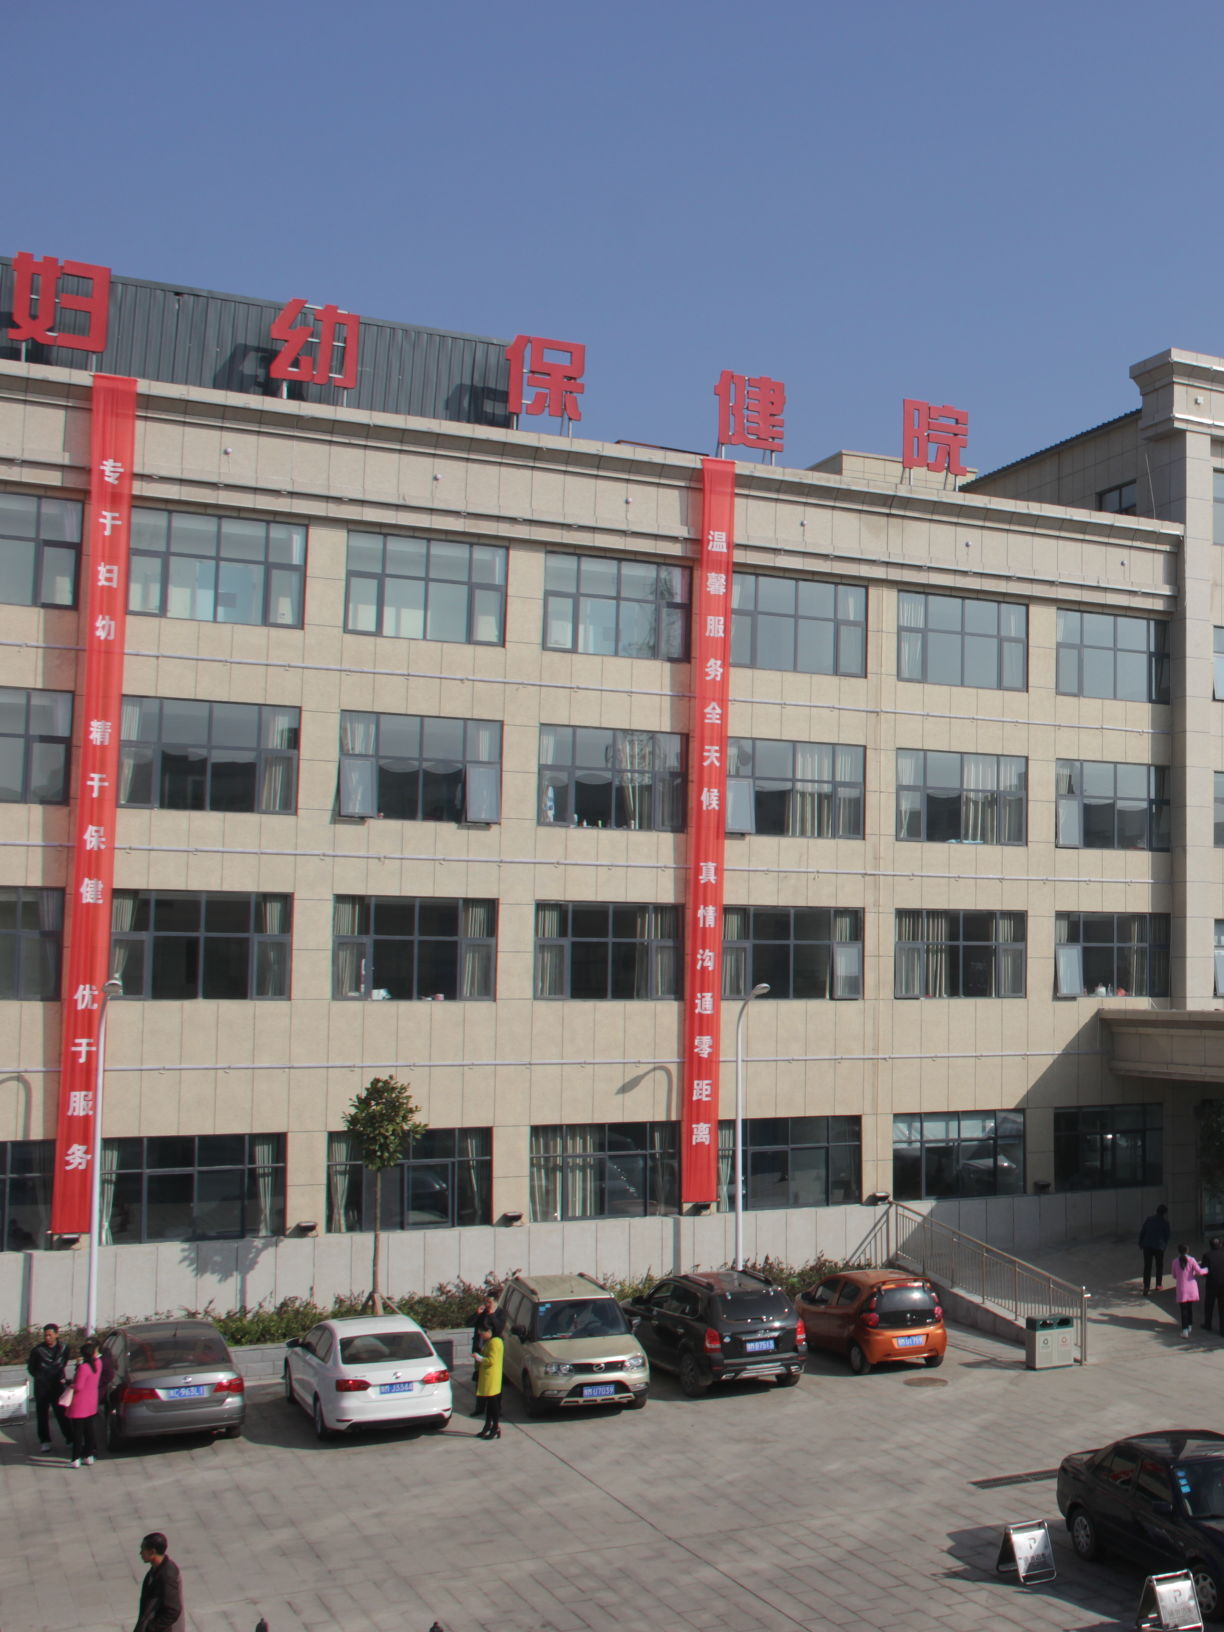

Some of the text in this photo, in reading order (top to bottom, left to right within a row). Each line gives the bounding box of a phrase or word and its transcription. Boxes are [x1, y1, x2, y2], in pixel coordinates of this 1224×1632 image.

[8, 251, 969, 476] 妇幼保健院
[64, 458, 125, 1171] 专于妇幼 精于保健 优于服务
[691, 530, 728, 1147] 温馨服务全天候 真情沟通零距离
